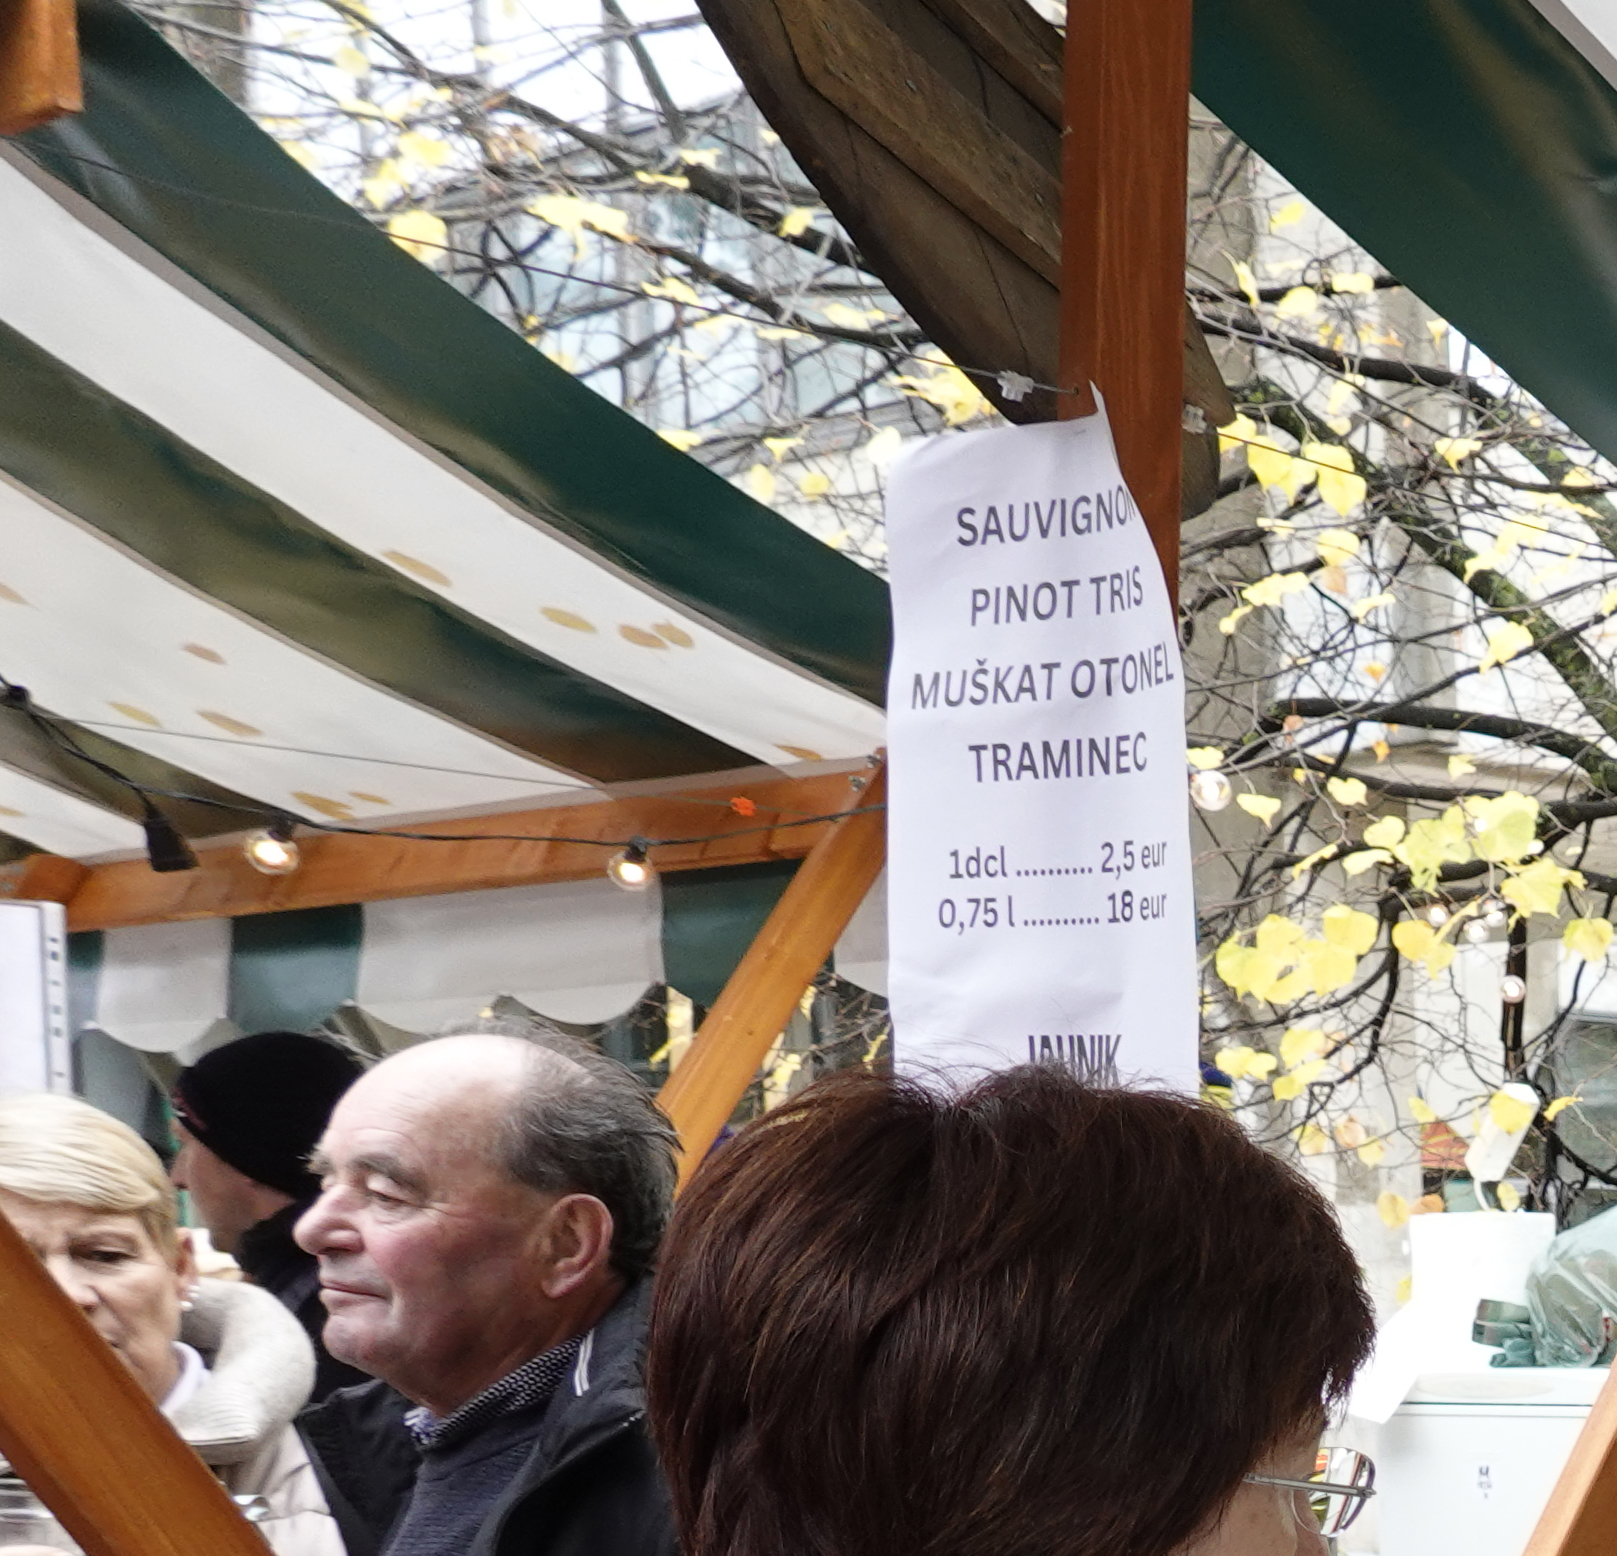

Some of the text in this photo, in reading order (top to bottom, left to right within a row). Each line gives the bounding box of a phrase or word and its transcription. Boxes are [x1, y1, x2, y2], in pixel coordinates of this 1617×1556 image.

[957, 485, 1137, 547] SAUVIGNON
[971, 565, 1143, 627] PINOT TRIS
[911, 641, 1174, 709] MUŠKAT OTONEL
[968, 731, 1147, 783] TRAMINEC
[949, 845, 1008, 879] 1dcl
[1100, 840, 1135, 880] 2,5
[1140, 841, 1167, 870] eur
[938, 897, 999, 935] 0,75
[1107, 889, 1134, 924] 18
[1139, 894, 1167, 921] eur
